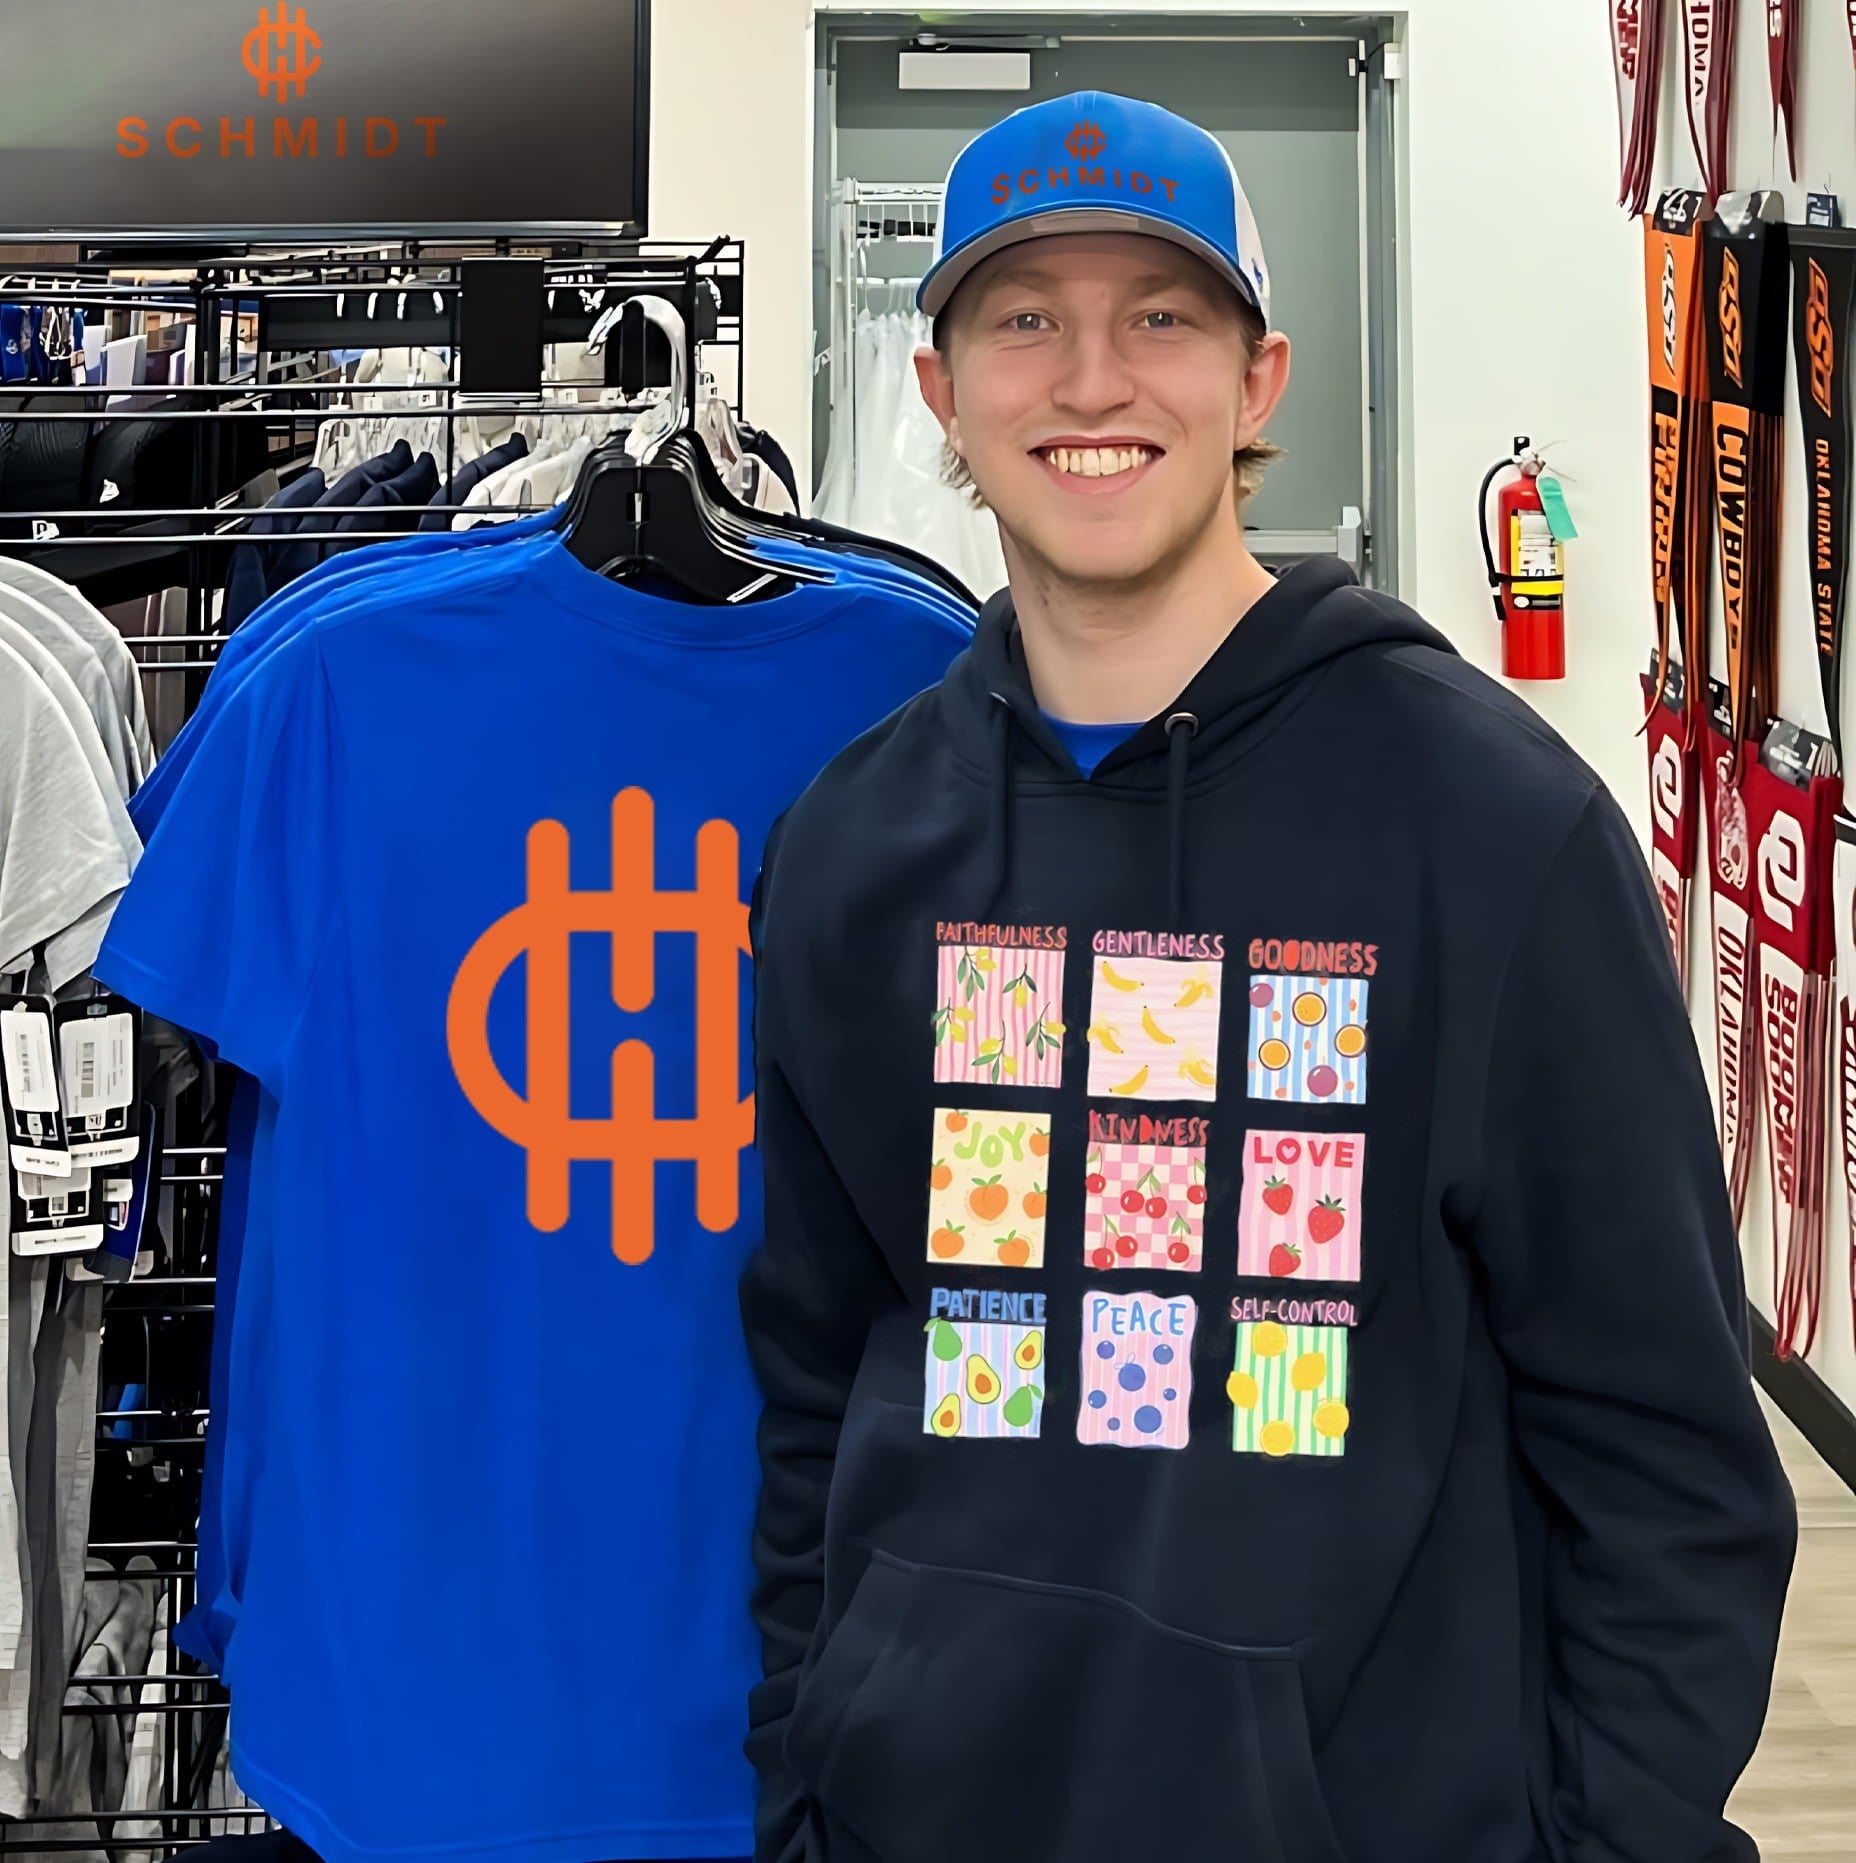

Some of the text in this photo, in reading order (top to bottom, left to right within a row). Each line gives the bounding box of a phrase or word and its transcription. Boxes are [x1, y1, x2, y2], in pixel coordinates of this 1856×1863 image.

[116, 116, 447, 159] SCHMIDT
[991, 166, 1179, 204] SCHMIDT
[1815, 438, 1832, 570] OKLAHOMA
[936, 921, 1068, 949] FAITHFULNESS
[1093, 929, 1225, 960] GENTLENESS
[1248, 938, 1379, 976] GOODNESS
[953, 1121, 1027, 1168] JOY
[1088, 1109, 1210, 1147] KINDNESS
[1253, 1136, 1354, 1168] LOVE
[930, 1288, 1047, 1324] PATIENCE
[1091, 1298, 1187, 1336] PEACE
[1230, 1296, 1358, 1327] SELF-CONTROL
